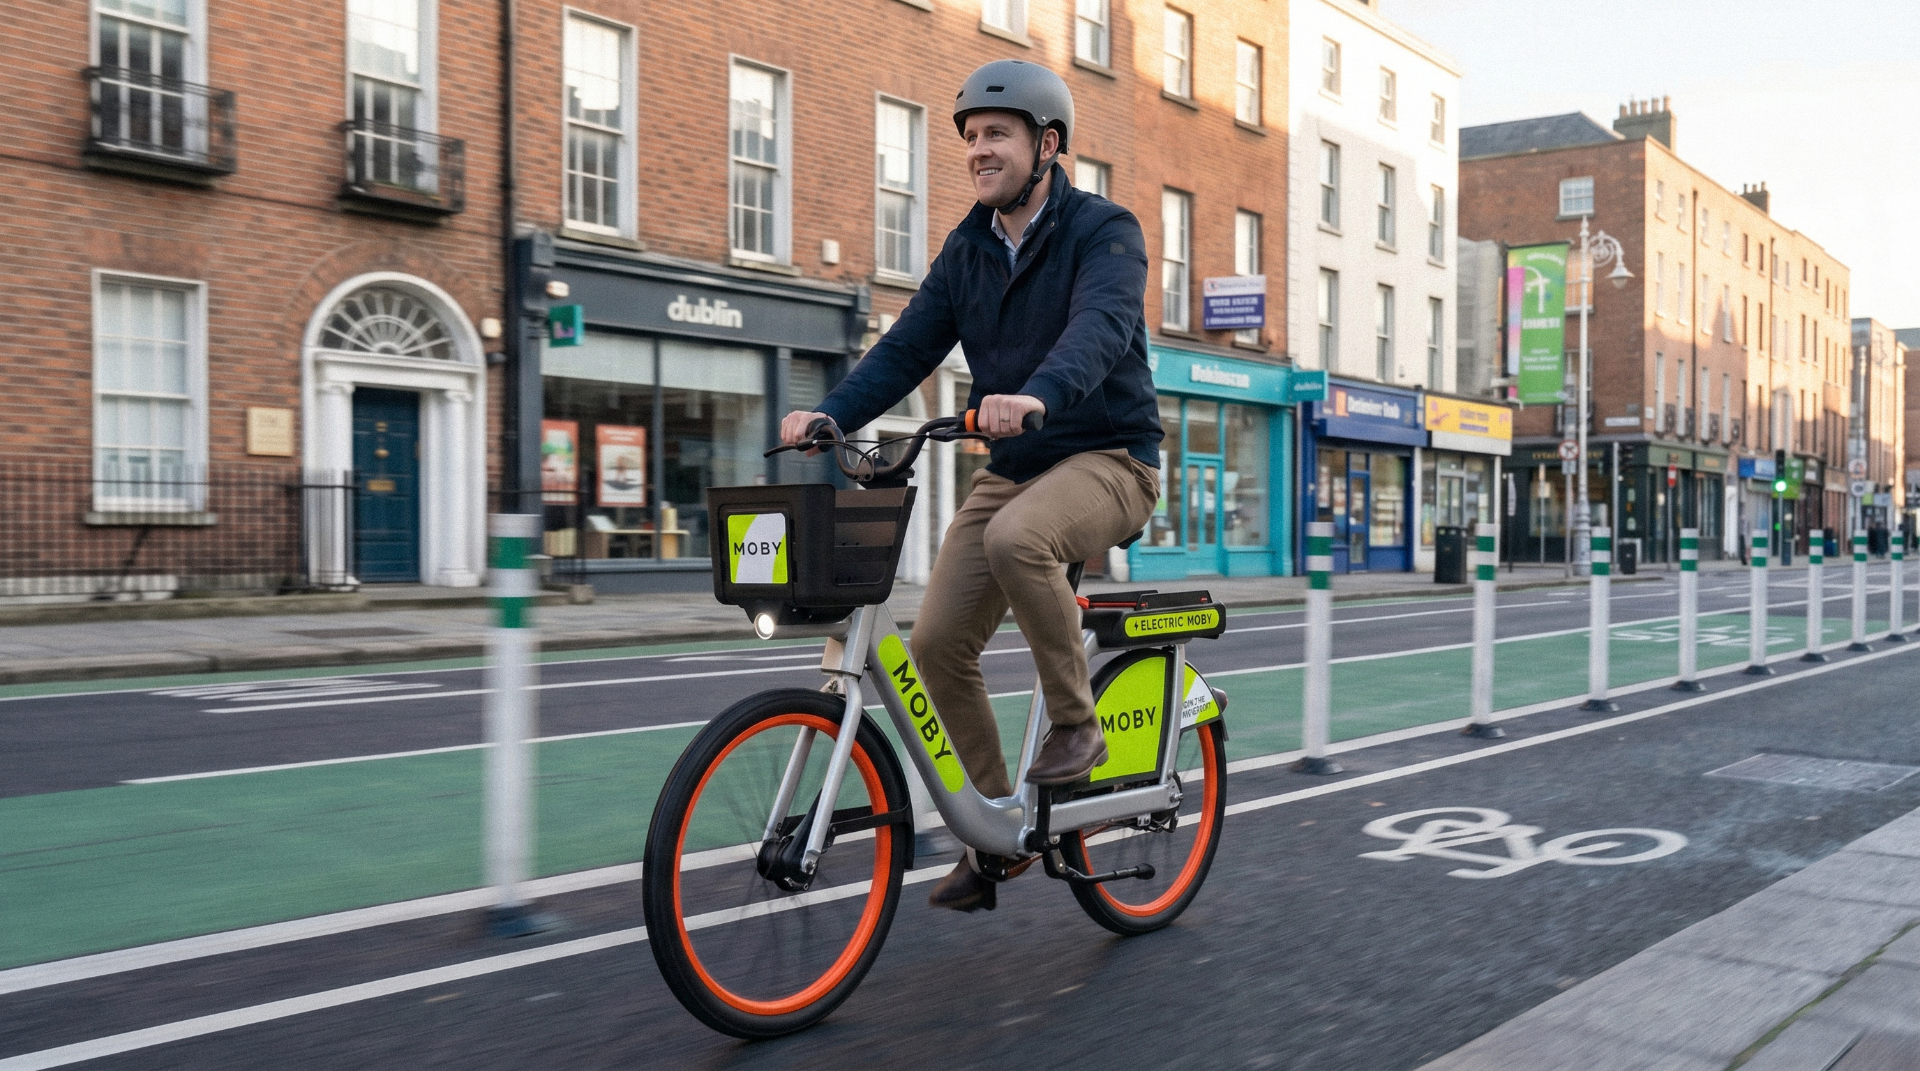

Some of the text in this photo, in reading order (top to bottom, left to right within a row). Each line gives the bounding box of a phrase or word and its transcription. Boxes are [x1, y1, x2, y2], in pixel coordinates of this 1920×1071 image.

[667, 294, 743, 329] dublin
[733, 541, 782, 556] MOBY
[1140, 613, 1213, 631] ELECTRIC MOBY
[892, 659, 953, 761] MOBY
[1100, 706, 1157, 734] MOBY
